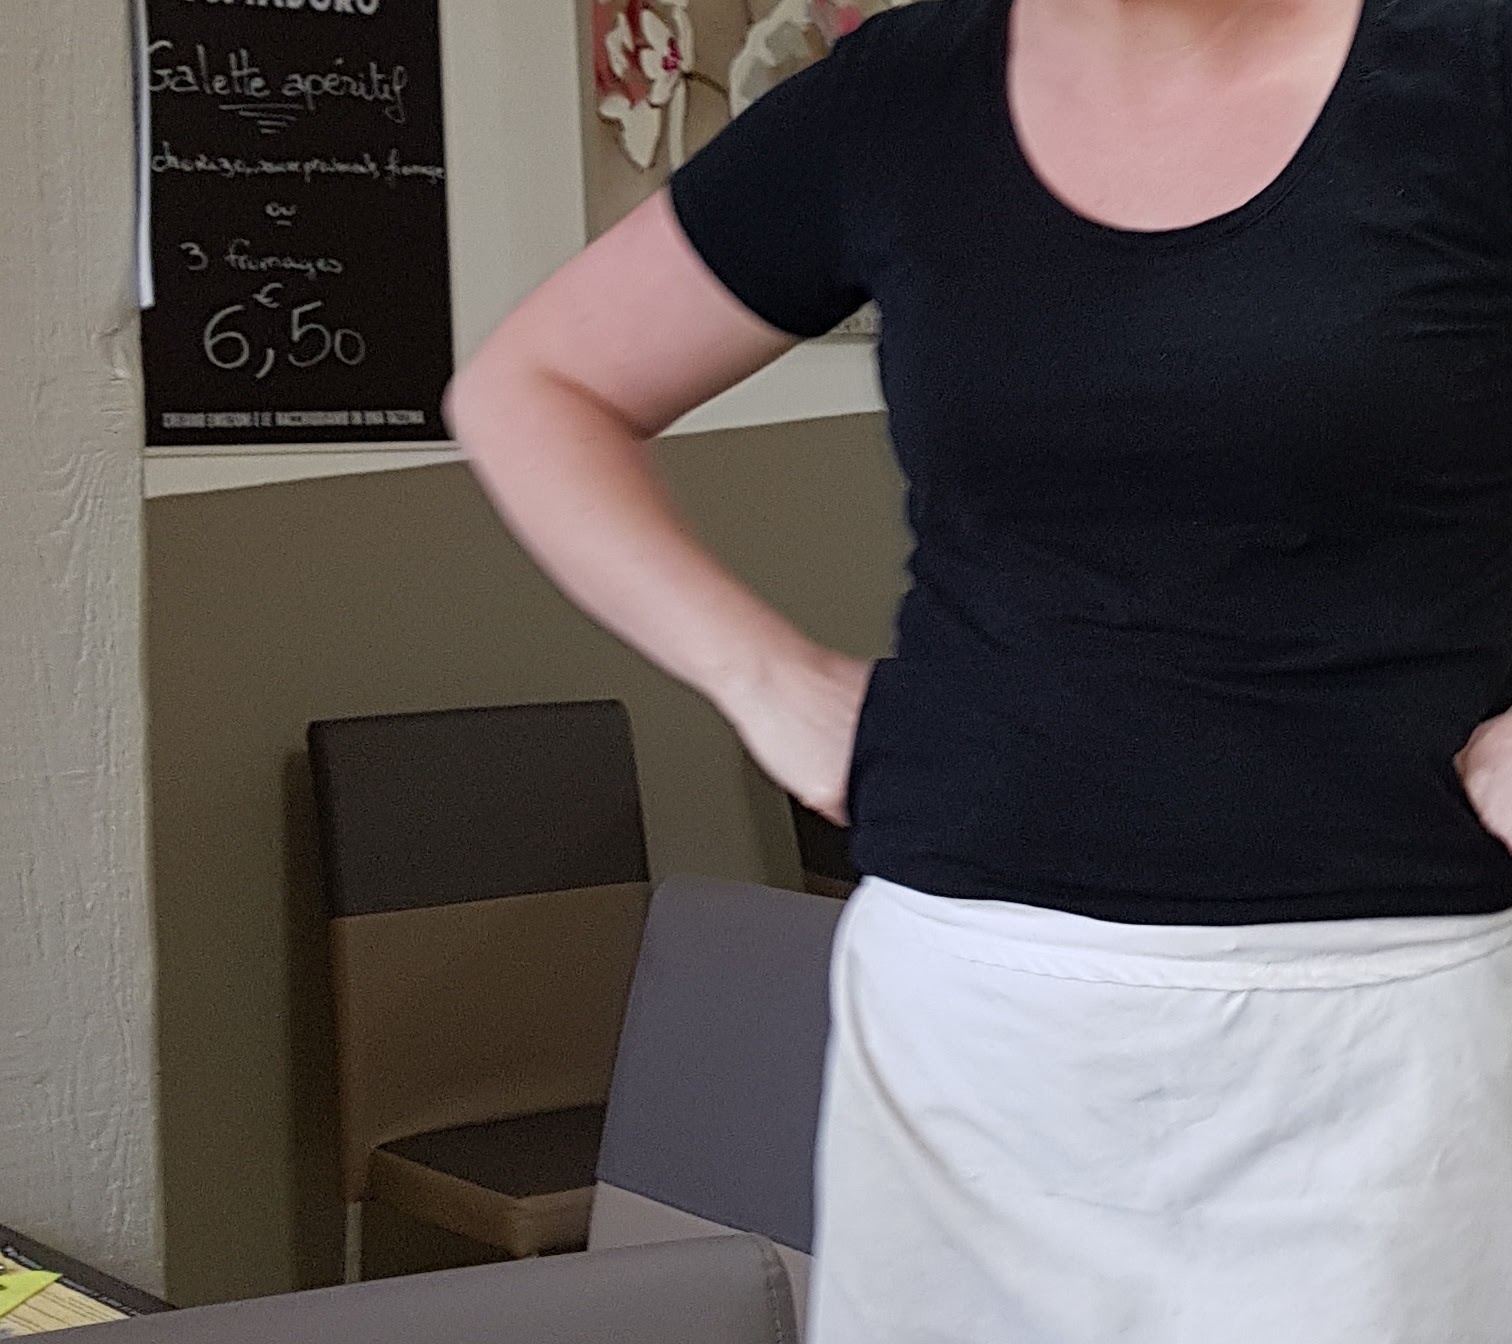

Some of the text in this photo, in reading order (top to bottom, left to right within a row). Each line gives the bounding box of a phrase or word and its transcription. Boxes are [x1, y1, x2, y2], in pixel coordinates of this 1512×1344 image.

[149, 40, 270, 97] Galette
[179, 241, 210, 271] 3
[203, 301, 366, 379] 6,50
